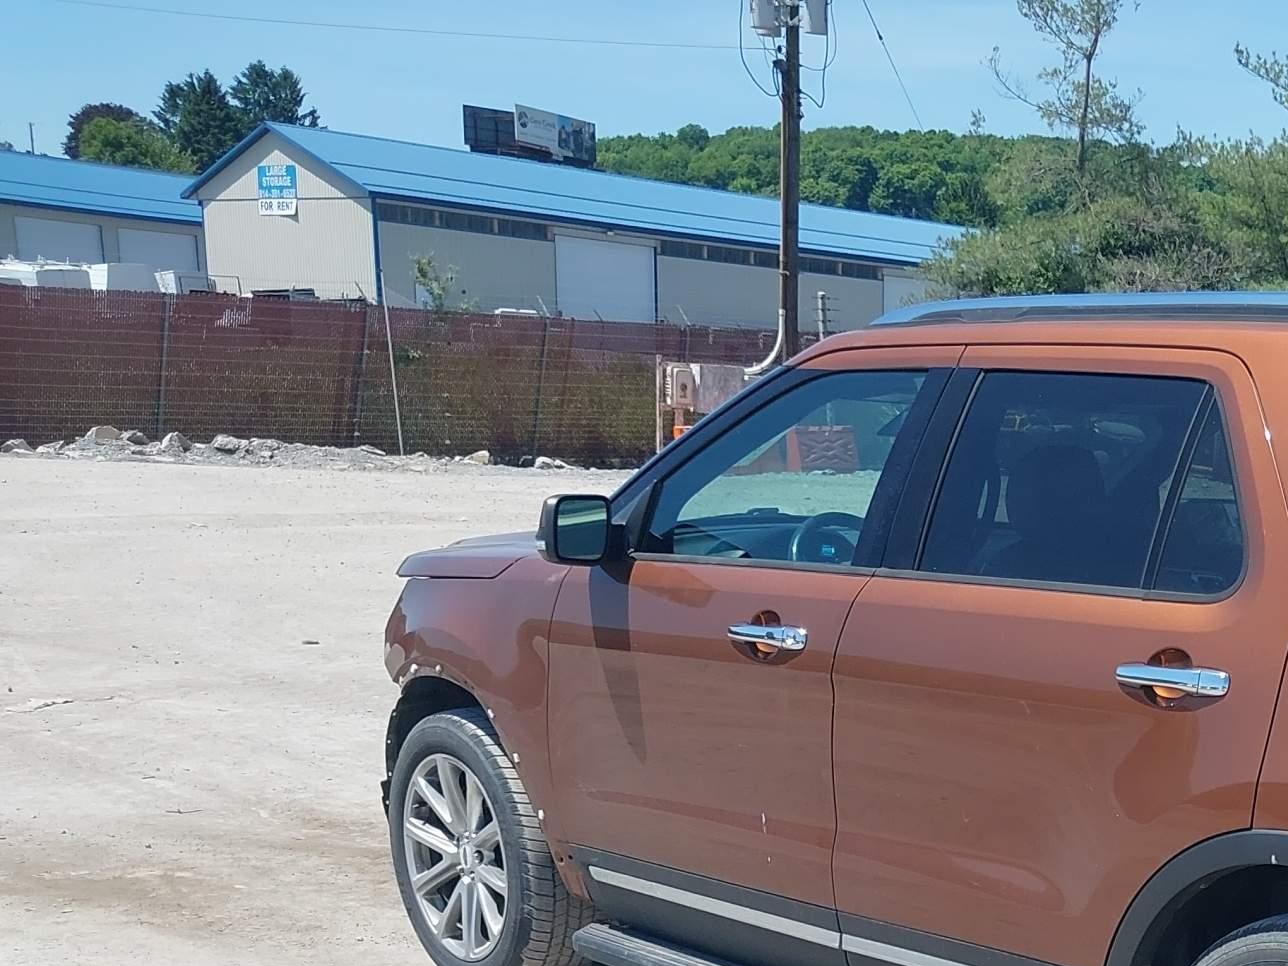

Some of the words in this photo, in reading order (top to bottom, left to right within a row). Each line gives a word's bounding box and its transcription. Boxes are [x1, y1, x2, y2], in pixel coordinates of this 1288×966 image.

[265, 165, 287, 176] LARGE
[262, 176, 292, 187] STORAGE
[260, 201, 273, 211] FOR
[277, 201, 293, 211] RENT
